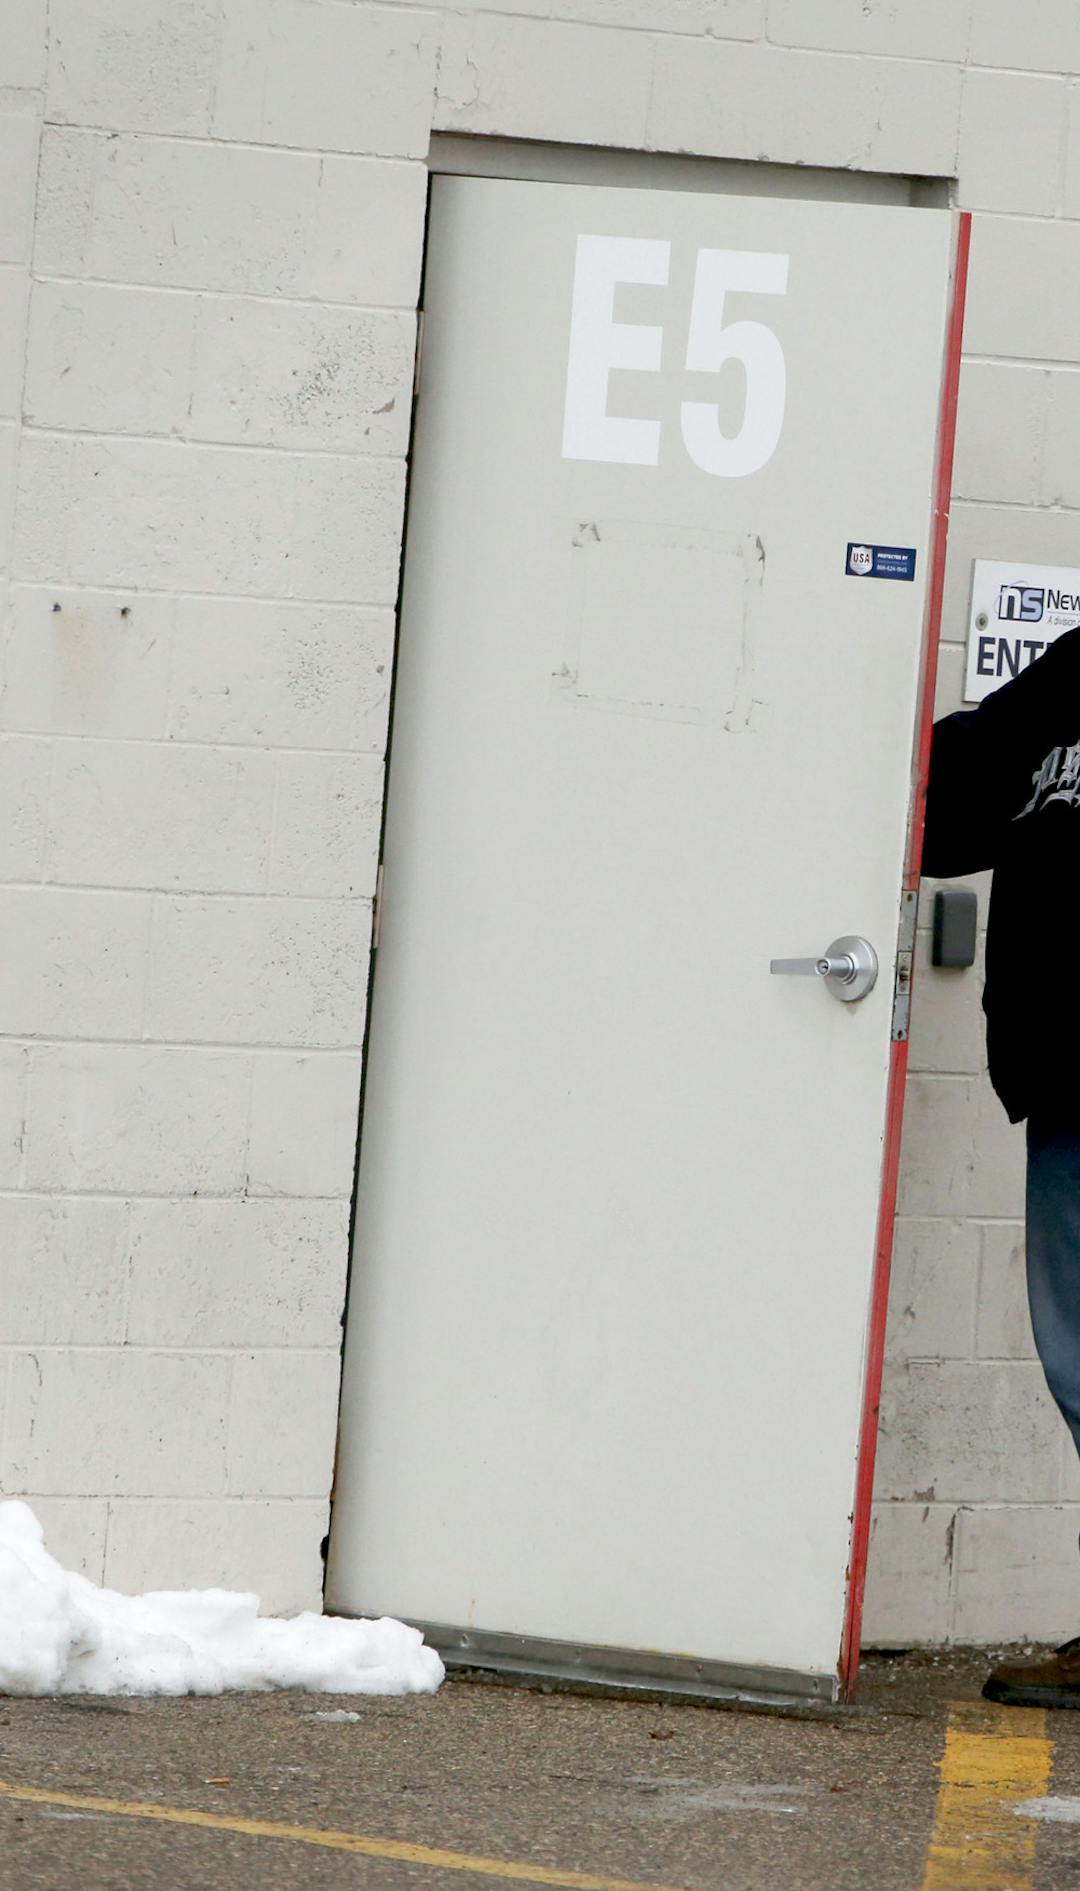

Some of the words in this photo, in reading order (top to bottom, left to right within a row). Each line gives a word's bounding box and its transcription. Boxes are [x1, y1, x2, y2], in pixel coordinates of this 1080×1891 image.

[561, 233, 790, 478] E5
[853, 552, 871, 564] USA
[976, 636, 1054, 678] ENT
